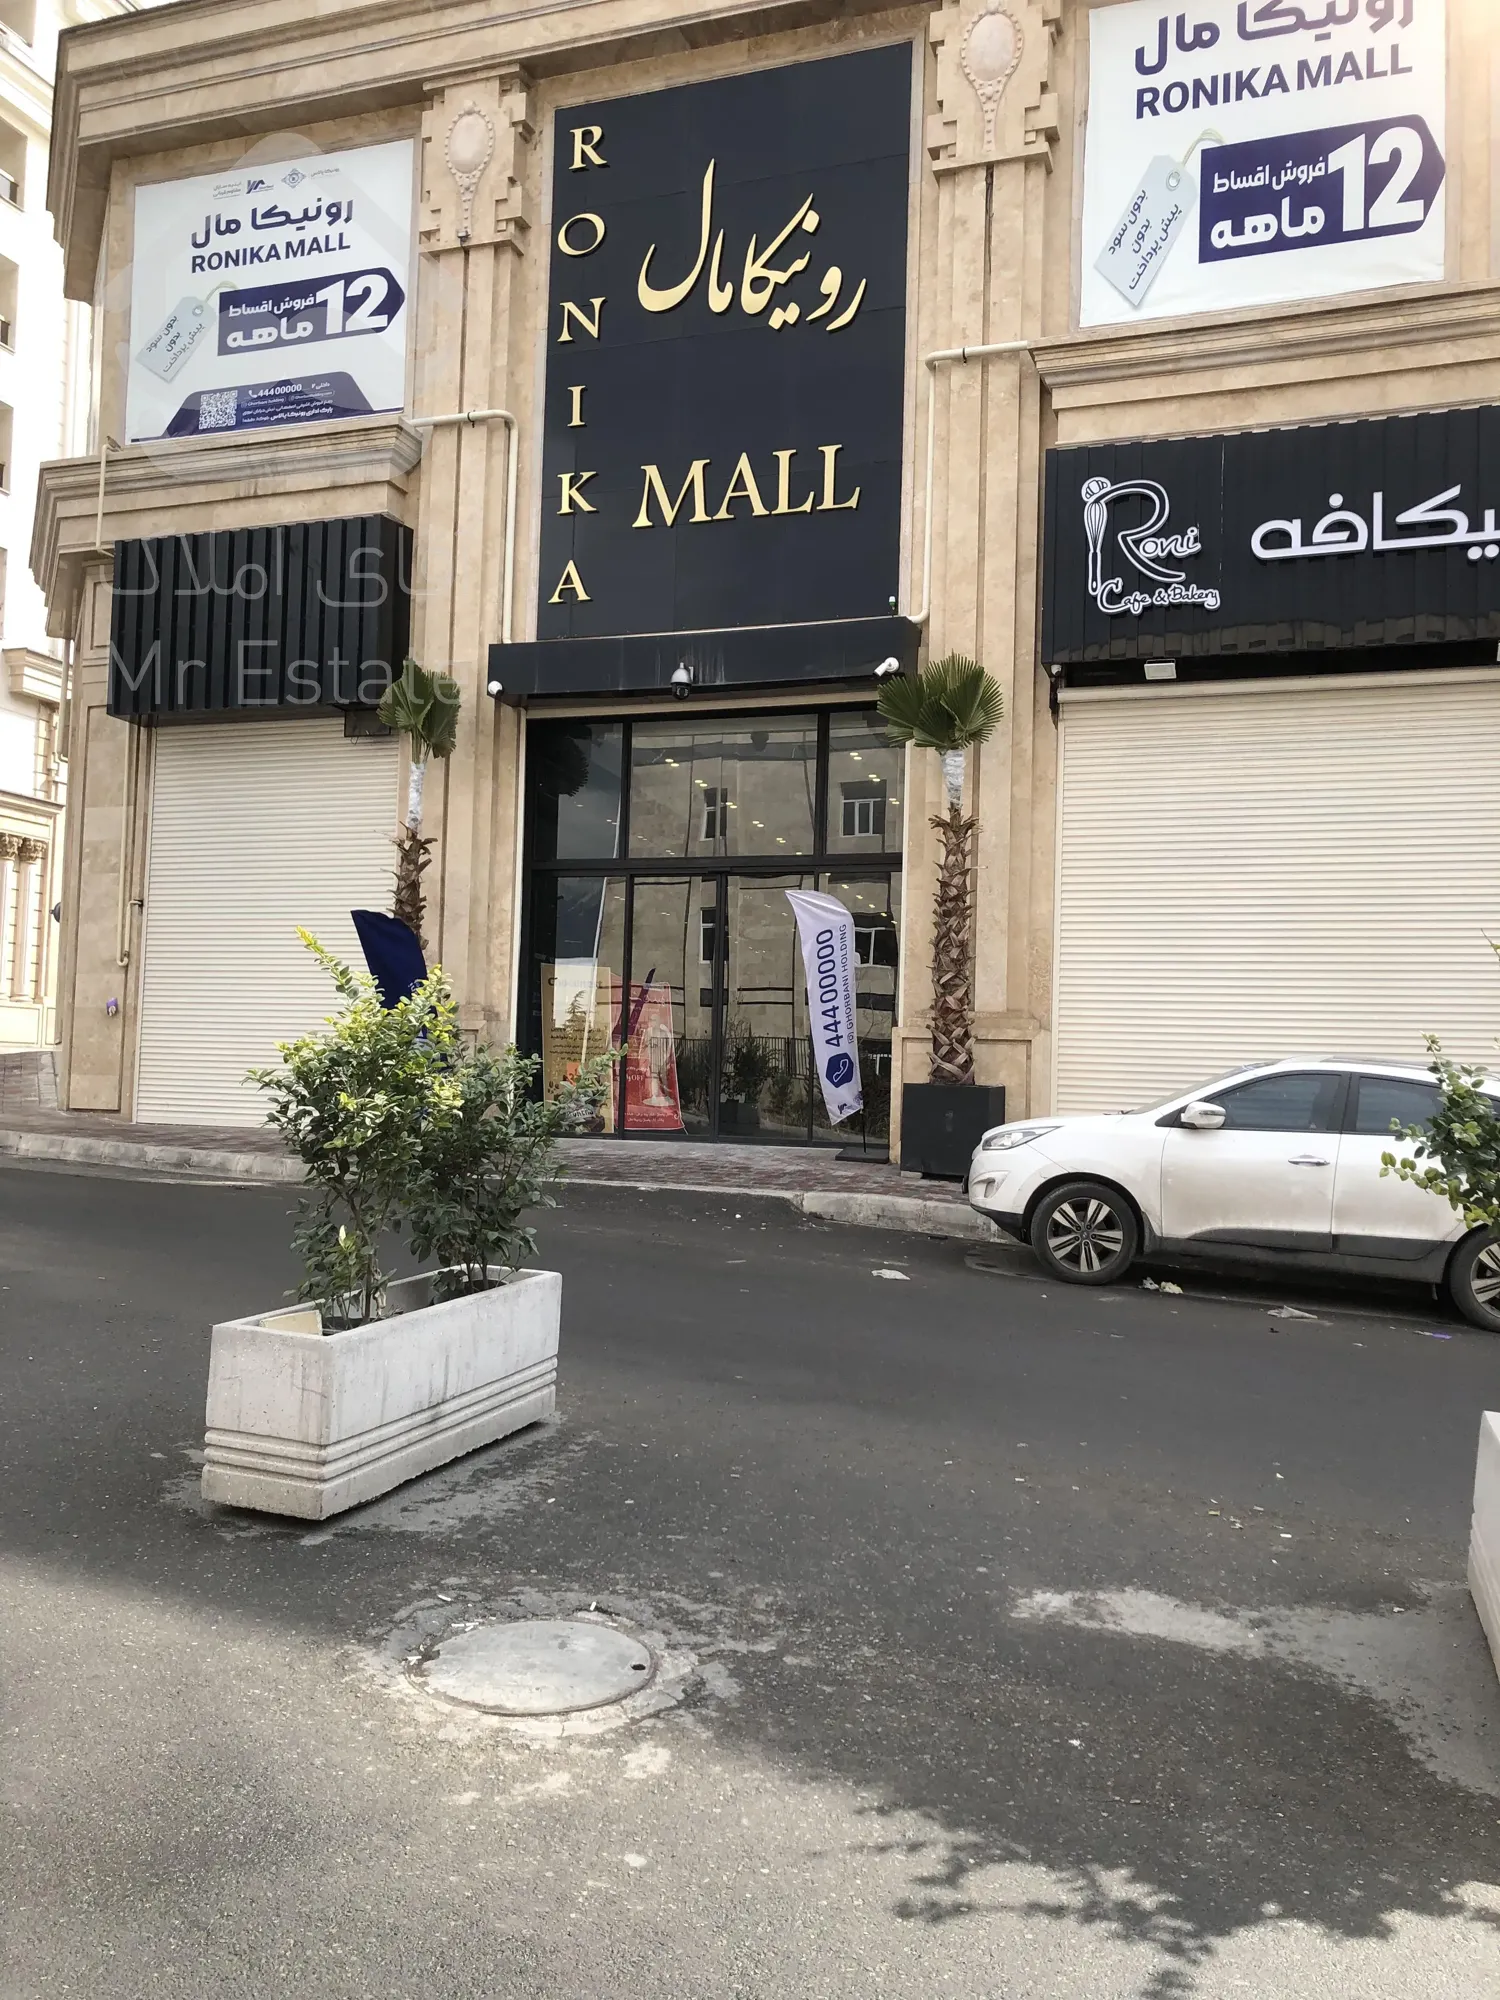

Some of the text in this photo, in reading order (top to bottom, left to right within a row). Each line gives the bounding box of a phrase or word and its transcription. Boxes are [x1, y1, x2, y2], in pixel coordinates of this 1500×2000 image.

[1135, 13, 1220, 75] مال
[1136, 44, 1412, 120] RONIKA MALL
[1213, 156, 1326, 194] فروش اقساط
[1327, 126, 1425, 232] 12
[191, 197, 354, 249] رونیکا مال
[191, 232, 351, 274] RONIKA MALL
[637, 158, 734, 313] مال
[1108, 189, 1148, 255] بدون سود
[1128, 203, 1182, 290] پیش پرداخت
[1131, 218, 1152, 255] بدون
[1210, 196, 1326, 249] ماهه
[226, 317, 314, 349] ماهه
[228, 292, 315, 318] فروش اقساط
[316, 273, 389, 336] 12
[257, 384, 303, 398] 44400000
[631, 443, 862, 529] MALL
[1088, 478, 1202, 590] Roni
[1098, 577, 1221, 615] Cafe & Bakery
[816, 928, 844, 1048] 44400000
[839, 923, 854, 1030] GHORBANI HOLDING
